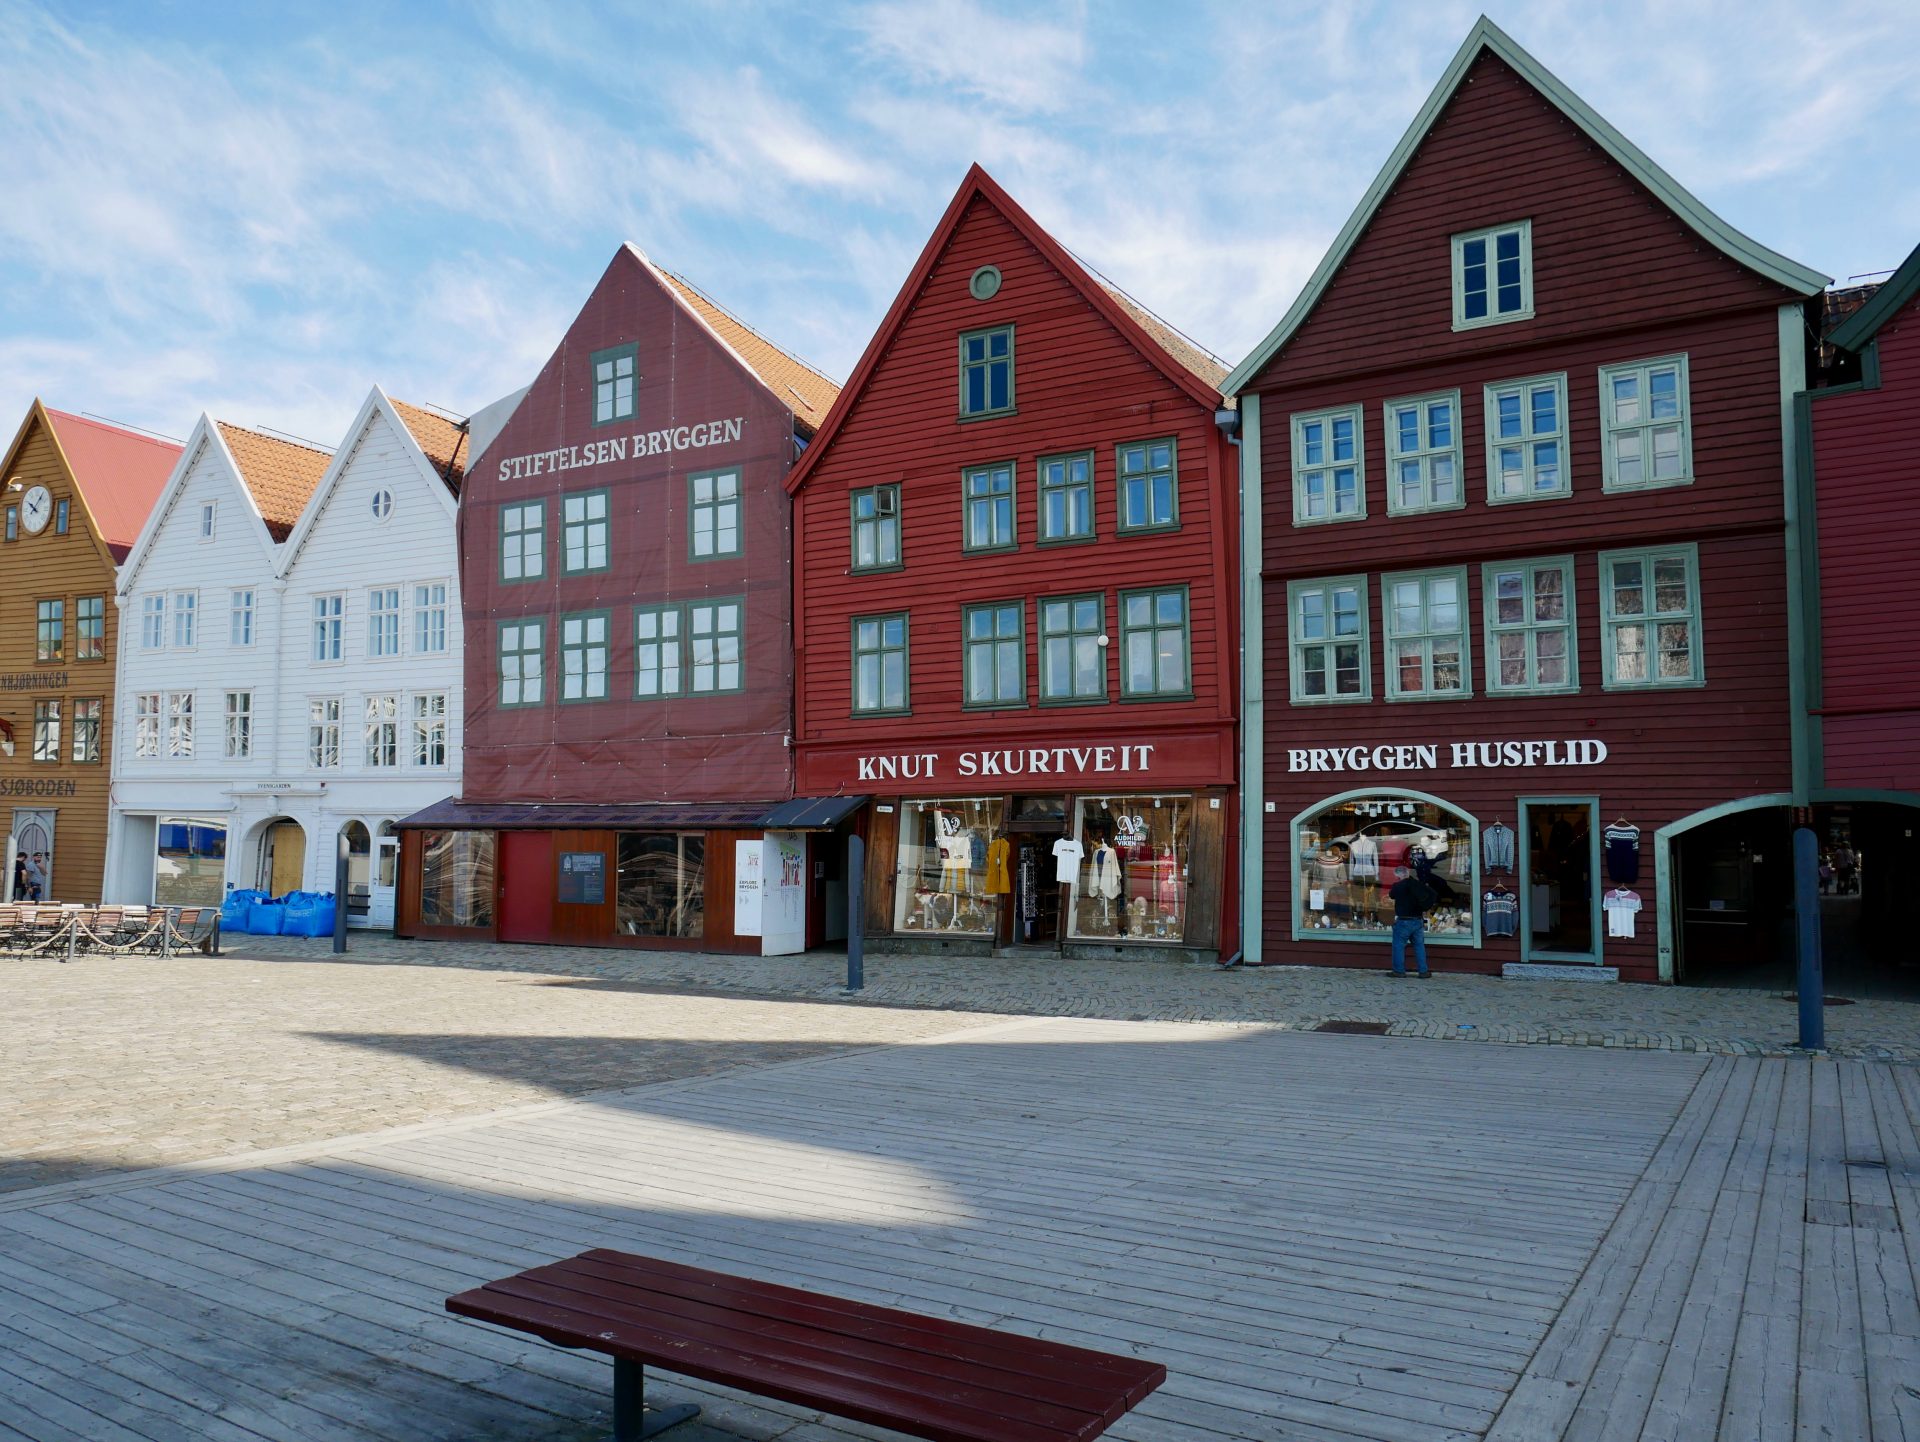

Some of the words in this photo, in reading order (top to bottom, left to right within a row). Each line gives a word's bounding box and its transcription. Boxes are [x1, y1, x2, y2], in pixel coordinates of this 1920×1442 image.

[498, 436, 629, 482] STIFTELSEN
[631, 416, 744, 459] BRYGGEN
[858, 753, 939, 781] KNUT
[958, 744, 1154, 776] SKURTVEIT
[1287, 744, 1439, 773] BRYGGEN
[1449, 739, 1608, 768] HUSFLID
[0, 778, 76, 796] SJØBODEN
